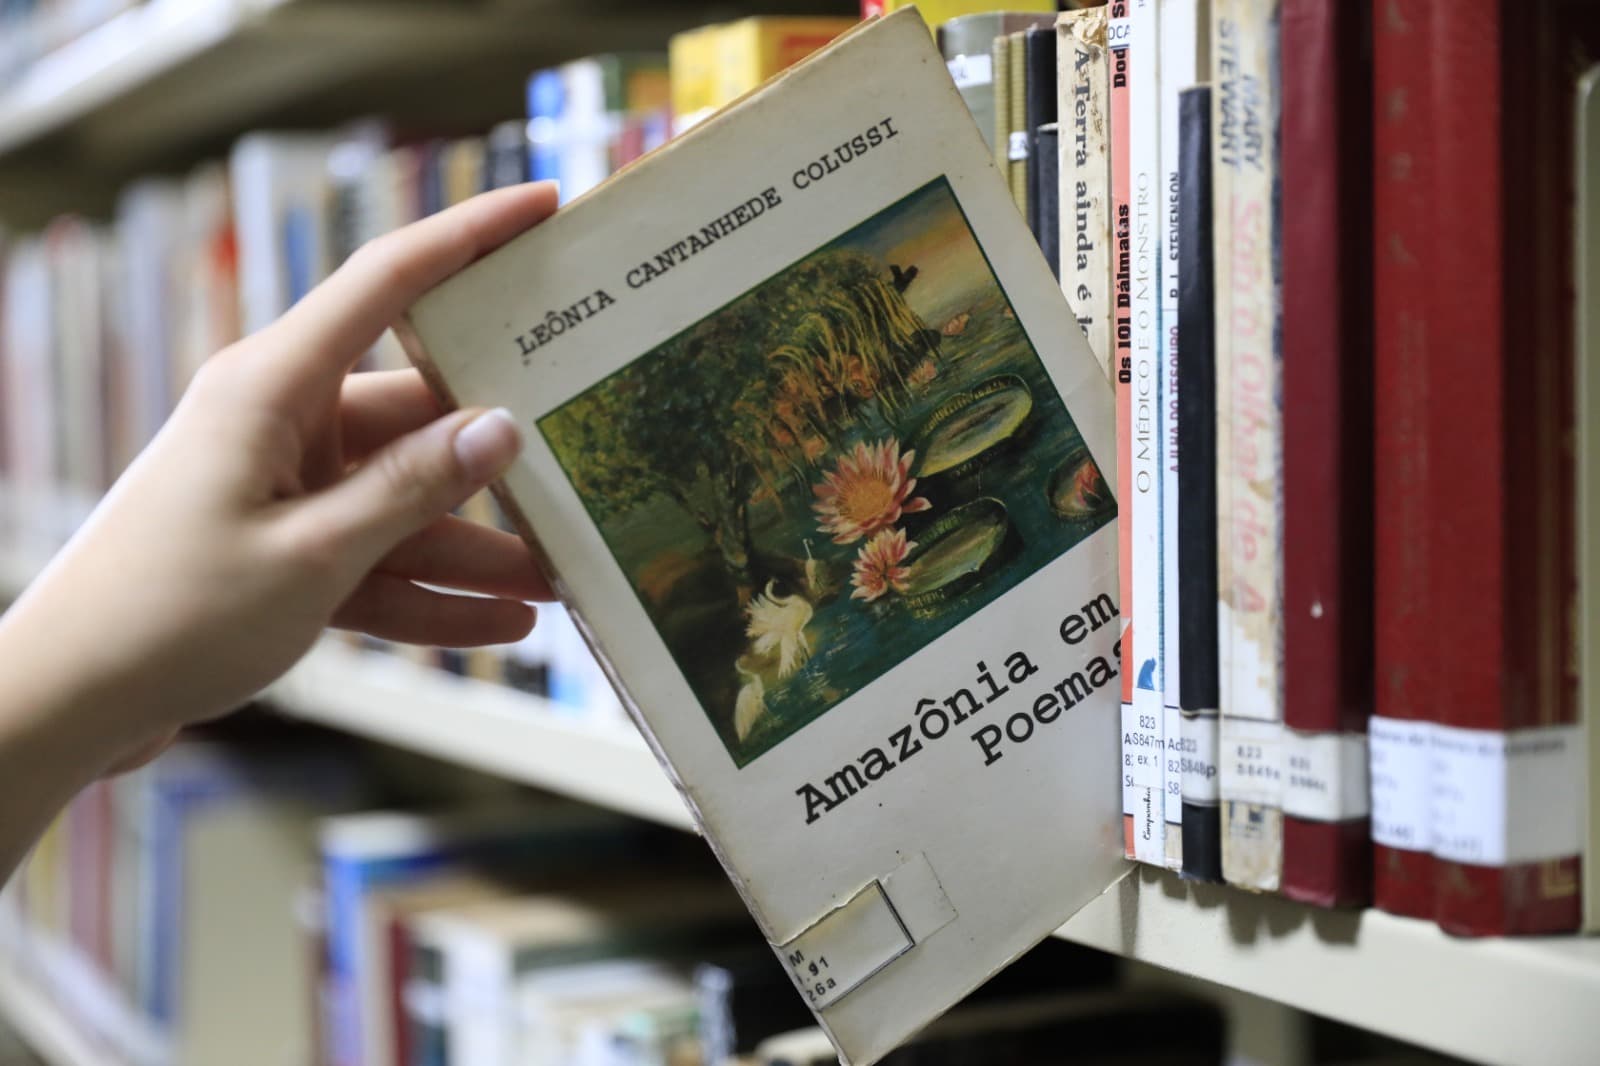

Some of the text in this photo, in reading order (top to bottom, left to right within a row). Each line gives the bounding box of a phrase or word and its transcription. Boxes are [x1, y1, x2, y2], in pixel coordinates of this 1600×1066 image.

[1074, 49, 1090, 71] A
[1112, 0, 1126, 88] Dod S
[1075, 78, 1090, 168] Terra
[1219, 17, 1241, 172] STEWART
[1242, 73, 1264, 172] MARY
[515, 117, 899, 356] LEÔNIA CANTANHEDE COLUSSI
[1076, 181, 1093, 272] ainda
[1116, 204, 1131, 309] Dálmatas
[1169, 171, 1178, 261] STEVENSON
[1077, 283, 1091, 301] é
[1137, 172, 1151, 493] O MÉDICO E O MONSTRO
[1118, 356, 1131, 384] Os
[1169, 326, 1178, 395] TESOURO
[795, 592, 1120, 825] Amazônia em
[1132, 732, 1165, 751] S847m
[1139, 715, 1156, 729] 823
[1167, 759, 1180, 774] 82
[789, 949, 805, 967] M
[805, 977, 837, 1002] 26a
